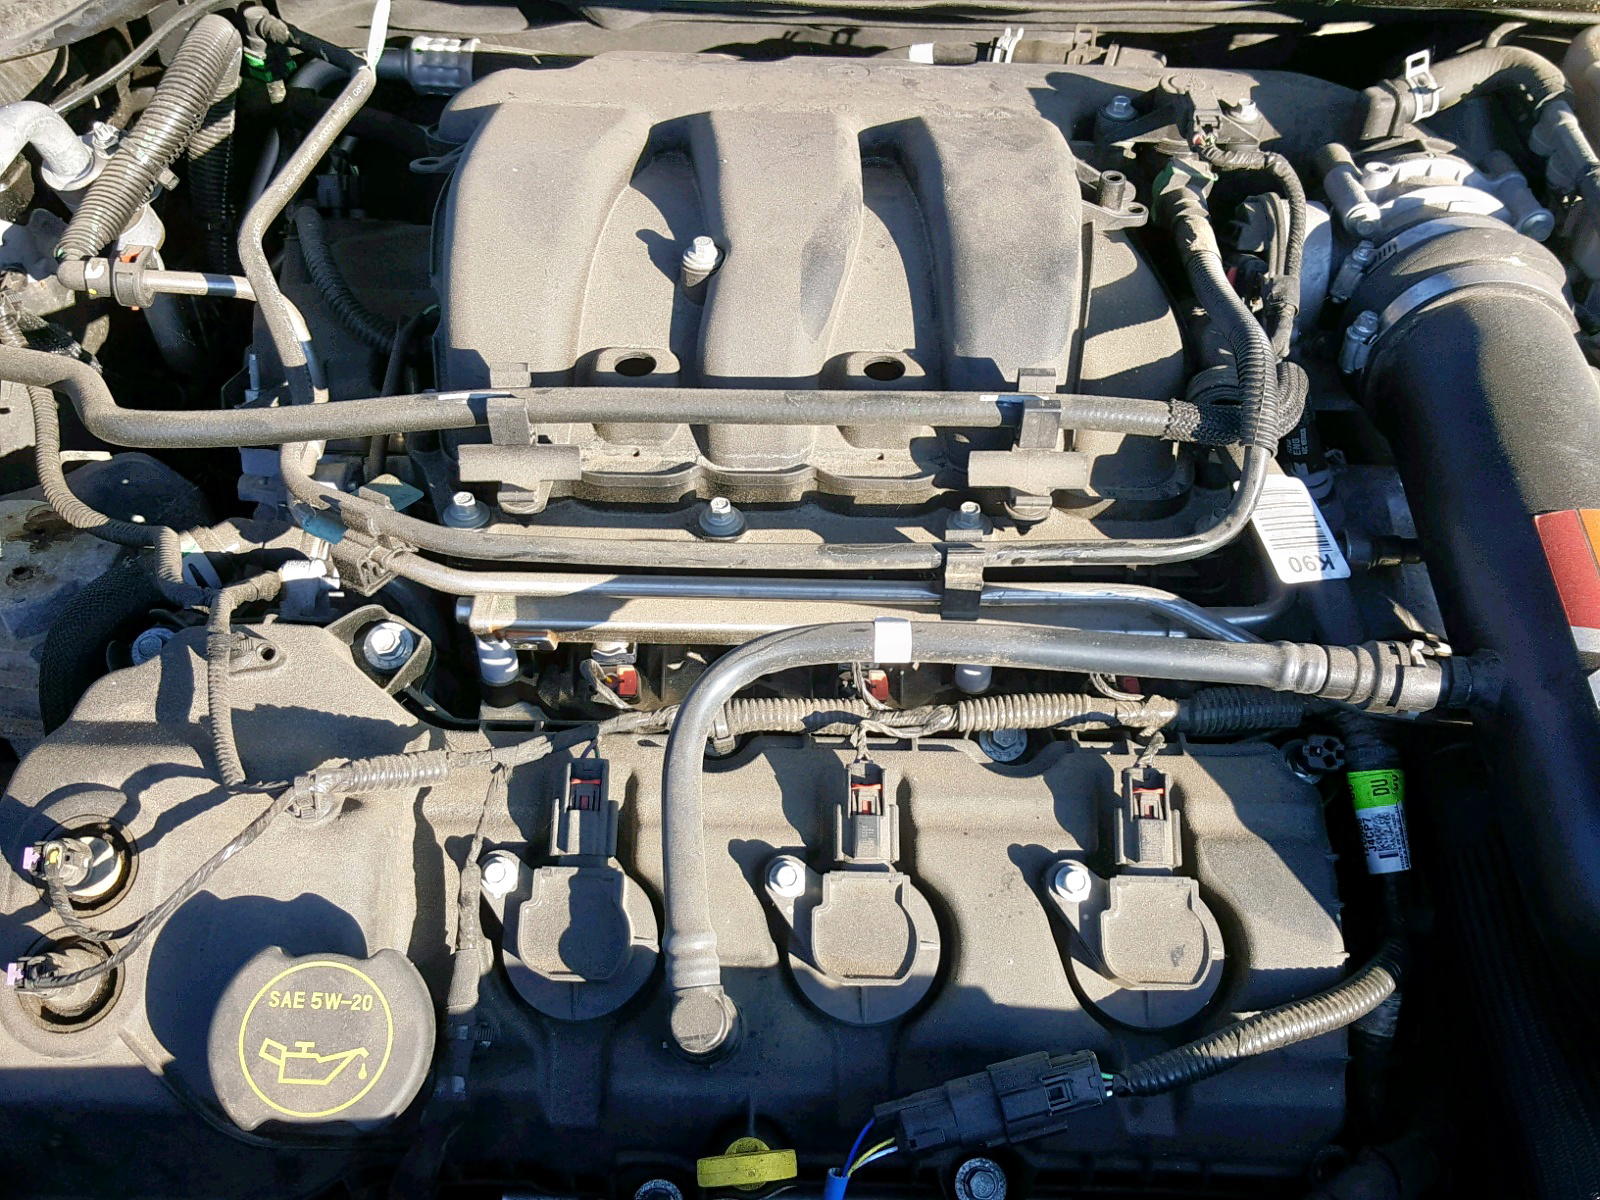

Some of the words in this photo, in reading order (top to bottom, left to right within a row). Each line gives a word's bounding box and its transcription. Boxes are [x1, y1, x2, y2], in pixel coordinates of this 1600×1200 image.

[1288, 554, 1335, 573] K90
[1370, 778, 1390, 797] DU
[268, 991, 306, 1009] SAE
[310, 992, 374, 1011] 5W-20
